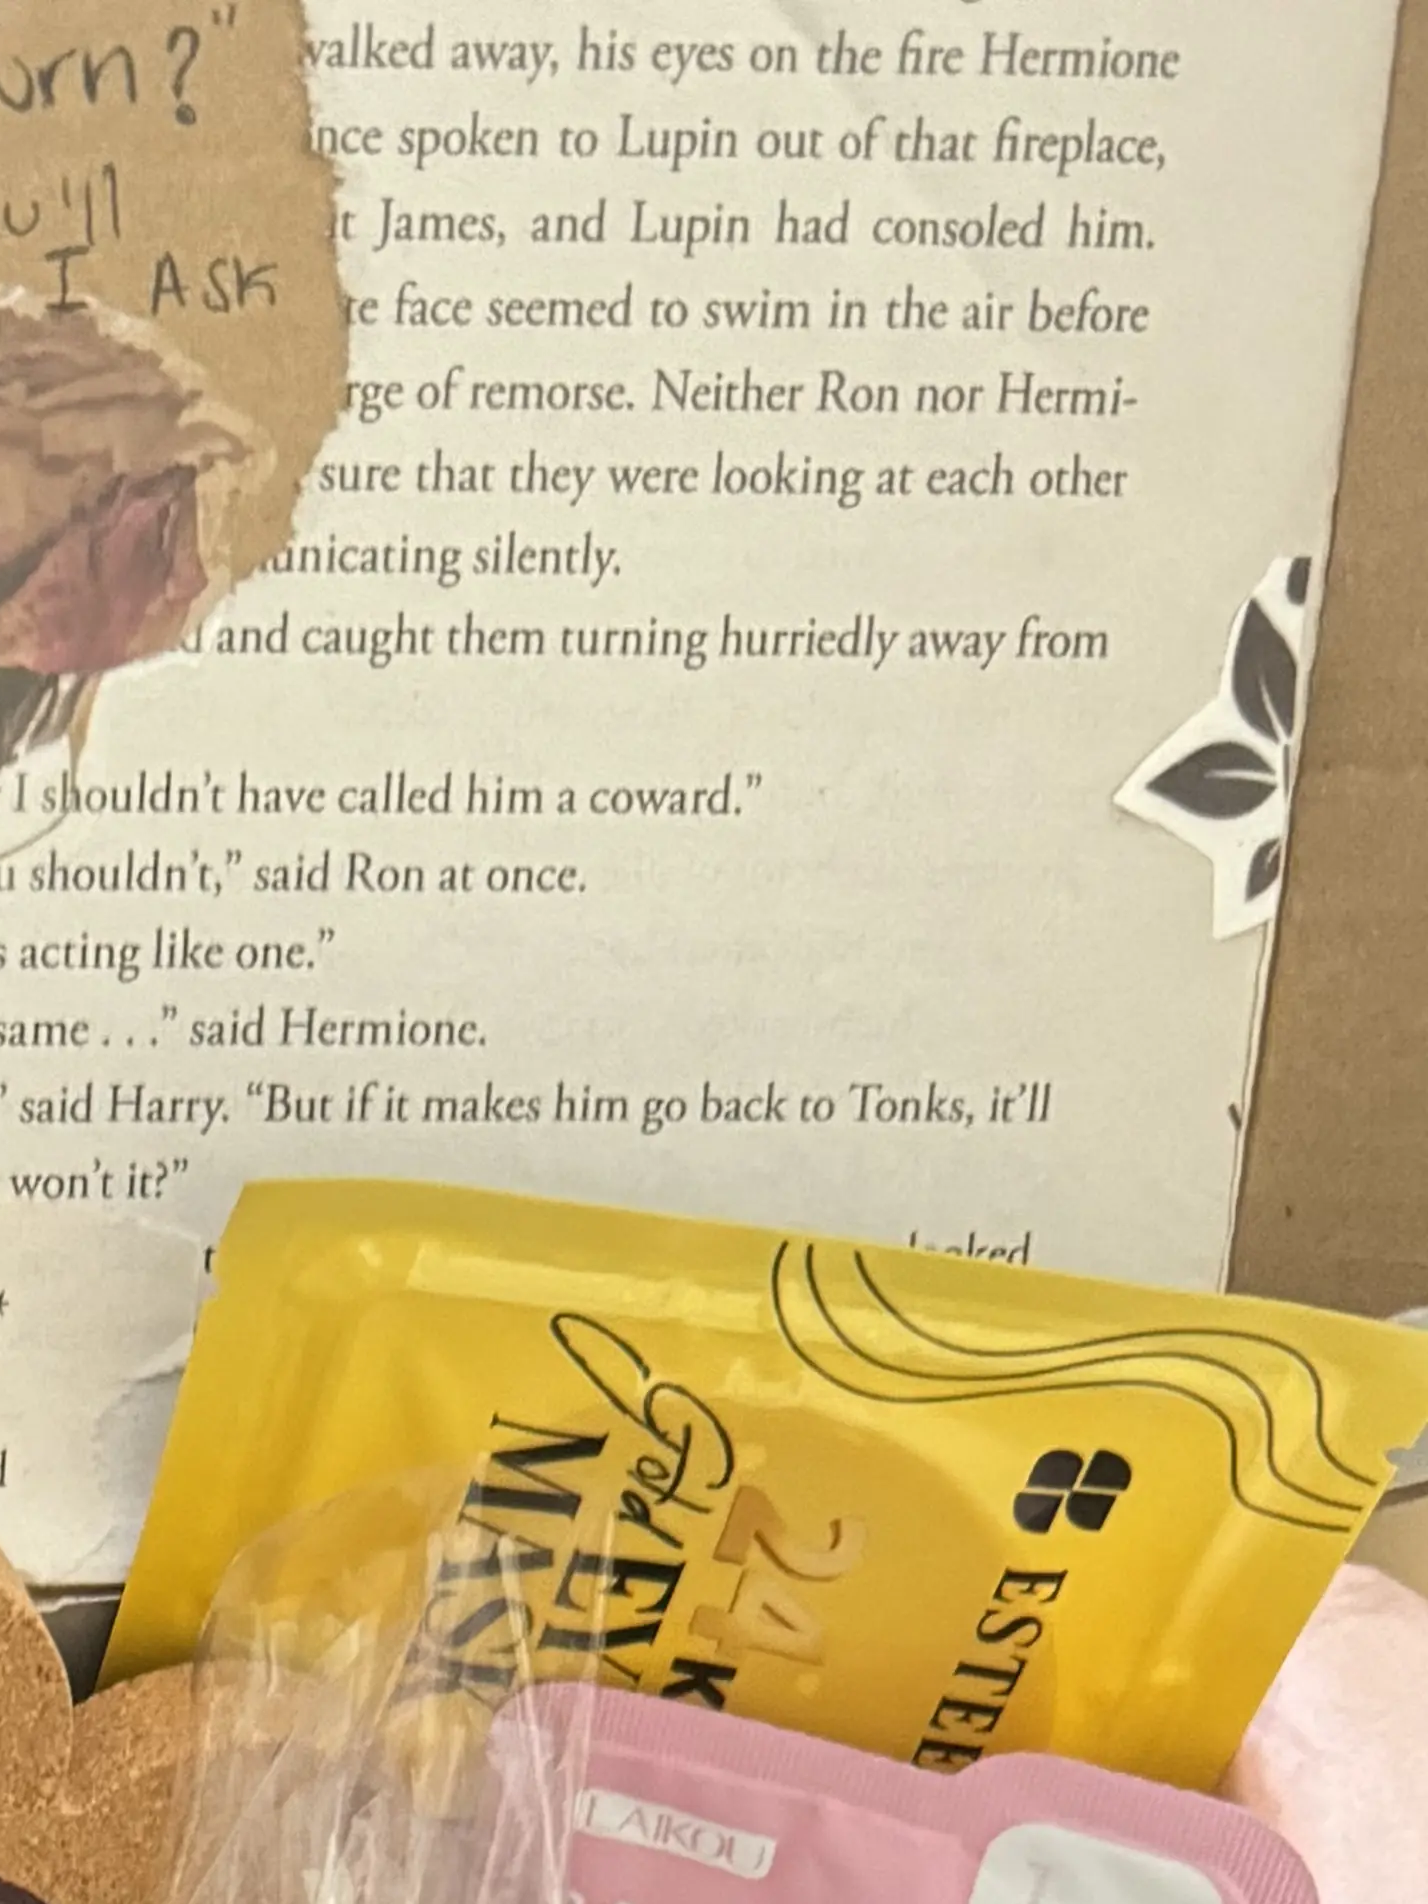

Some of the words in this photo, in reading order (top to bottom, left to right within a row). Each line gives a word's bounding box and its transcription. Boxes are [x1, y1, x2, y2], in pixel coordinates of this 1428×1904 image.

[448, 38, 560, 87] away,
[575, 21, 637, 73] his
[649, 40, 736, 87] eyes
[747, 42, 799, 75] on
[814, 26, 884, 76] the
[895, 25, 966, 77] fire
[977, 29, 1182, 81] Hermione
[151, 258, 277, 316] ASK
[28, 846, 243, 898] shouldn't,"
[251, 846, 331, 893] said
[344, 850, 425, 894] Ron
[436, 860, 475, 893] at
[484, 864, 587, 894] once.
[17, 1079, 94, 1125] said
[106, 1082, 230, 1137] Harry.
[244, 1079, 334, 1124] "But
[343, 1079, 379, 1124] if
[381, 1080, 410, 1124] it
[419, 1078, 542, 1124] makes
[551, 1077, 629, 1124] him
[638, 1095, 688, 1137] go
[698, 1078, 789, 1124] back
[797, 1093, 836, 1124] to
[847, 1079, 975, 1129] Tonks,
[986, 1079, 1053, 1124] it'll
[537, 1549, 686, 1683] EY
